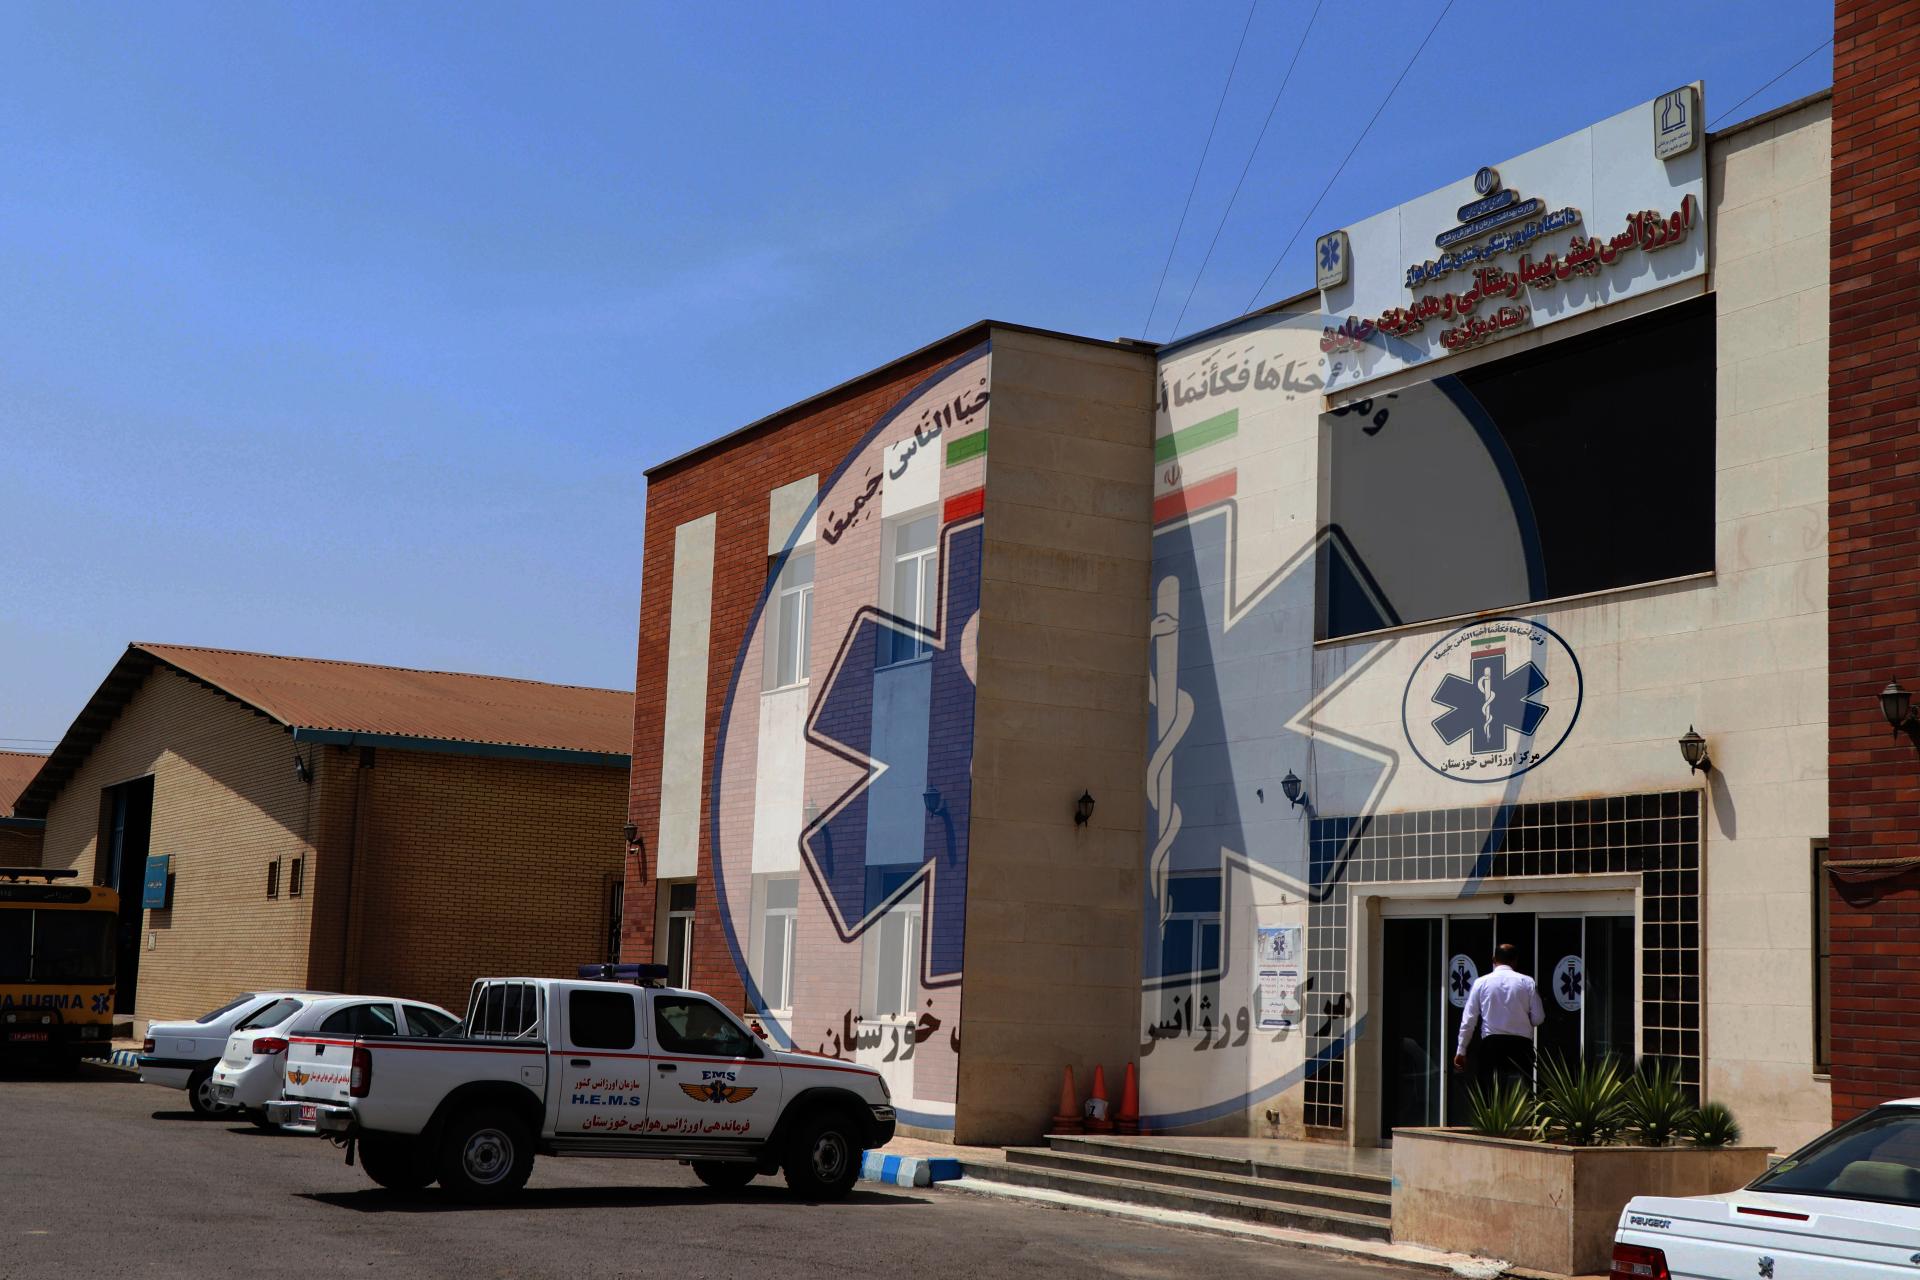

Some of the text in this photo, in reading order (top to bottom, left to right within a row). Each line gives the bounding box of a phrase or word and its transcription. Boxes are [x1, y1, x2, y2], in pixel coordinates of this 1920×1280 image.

[1517, 203, 1534, 214] وزارت
[1480, 218, 1494, 230] درمان
[1538, 207, 1576, 235] دانشگاه
[1516, 223, 1537, 245] علوم
[1482, 234, 1515, 258] پزشکی
[1454, 247, 1481, 269] جندی
[1320, 194, 1695, 354] اورژانس پیش بیمارستانی و مدیریت حوادث
[1440, 750, 1540, 772] مرکز اورژانس خوزستان
[575, 1077, 640, 1092] سازمان اورژانس کشور
[701, 1070, 736, 1082] EMS
[572, 1094, 640, 1106] H.E.M.S
[582, 1115, 750, 1135] فرماندهی اورژانس هوایی خوزستان
[1630, 1216, 1672, 1229] PEUGEOT
